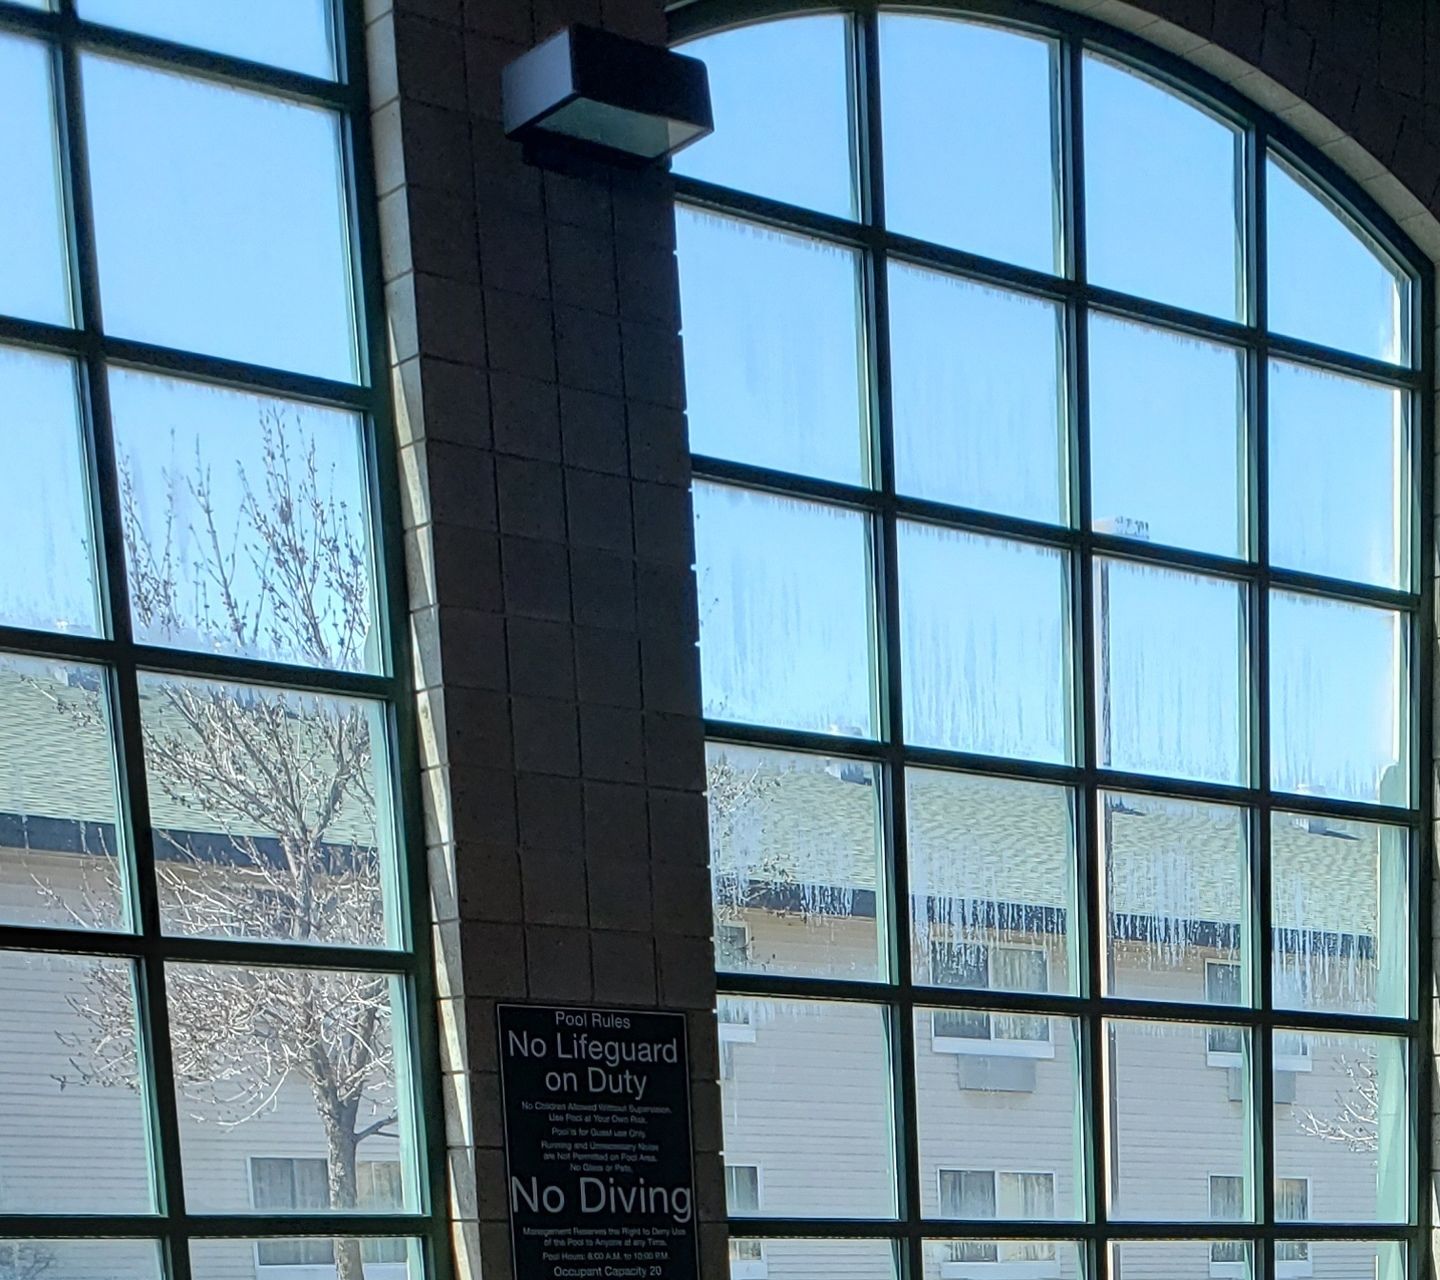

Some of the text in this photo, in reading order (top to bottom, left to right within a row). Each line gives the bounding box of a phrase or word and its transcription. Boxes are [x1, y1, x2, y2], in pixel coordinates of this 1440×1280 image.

[555, 1011, 631, 1030] Pool Rules
[508, 1030, 678, 1065] No Lifeguard
[545, 1067, 647, 1100] on Duty
[511, 1175, 692, 1223] No Diving
[553, 1265, 662, 1278] Occupant Capacity 20
